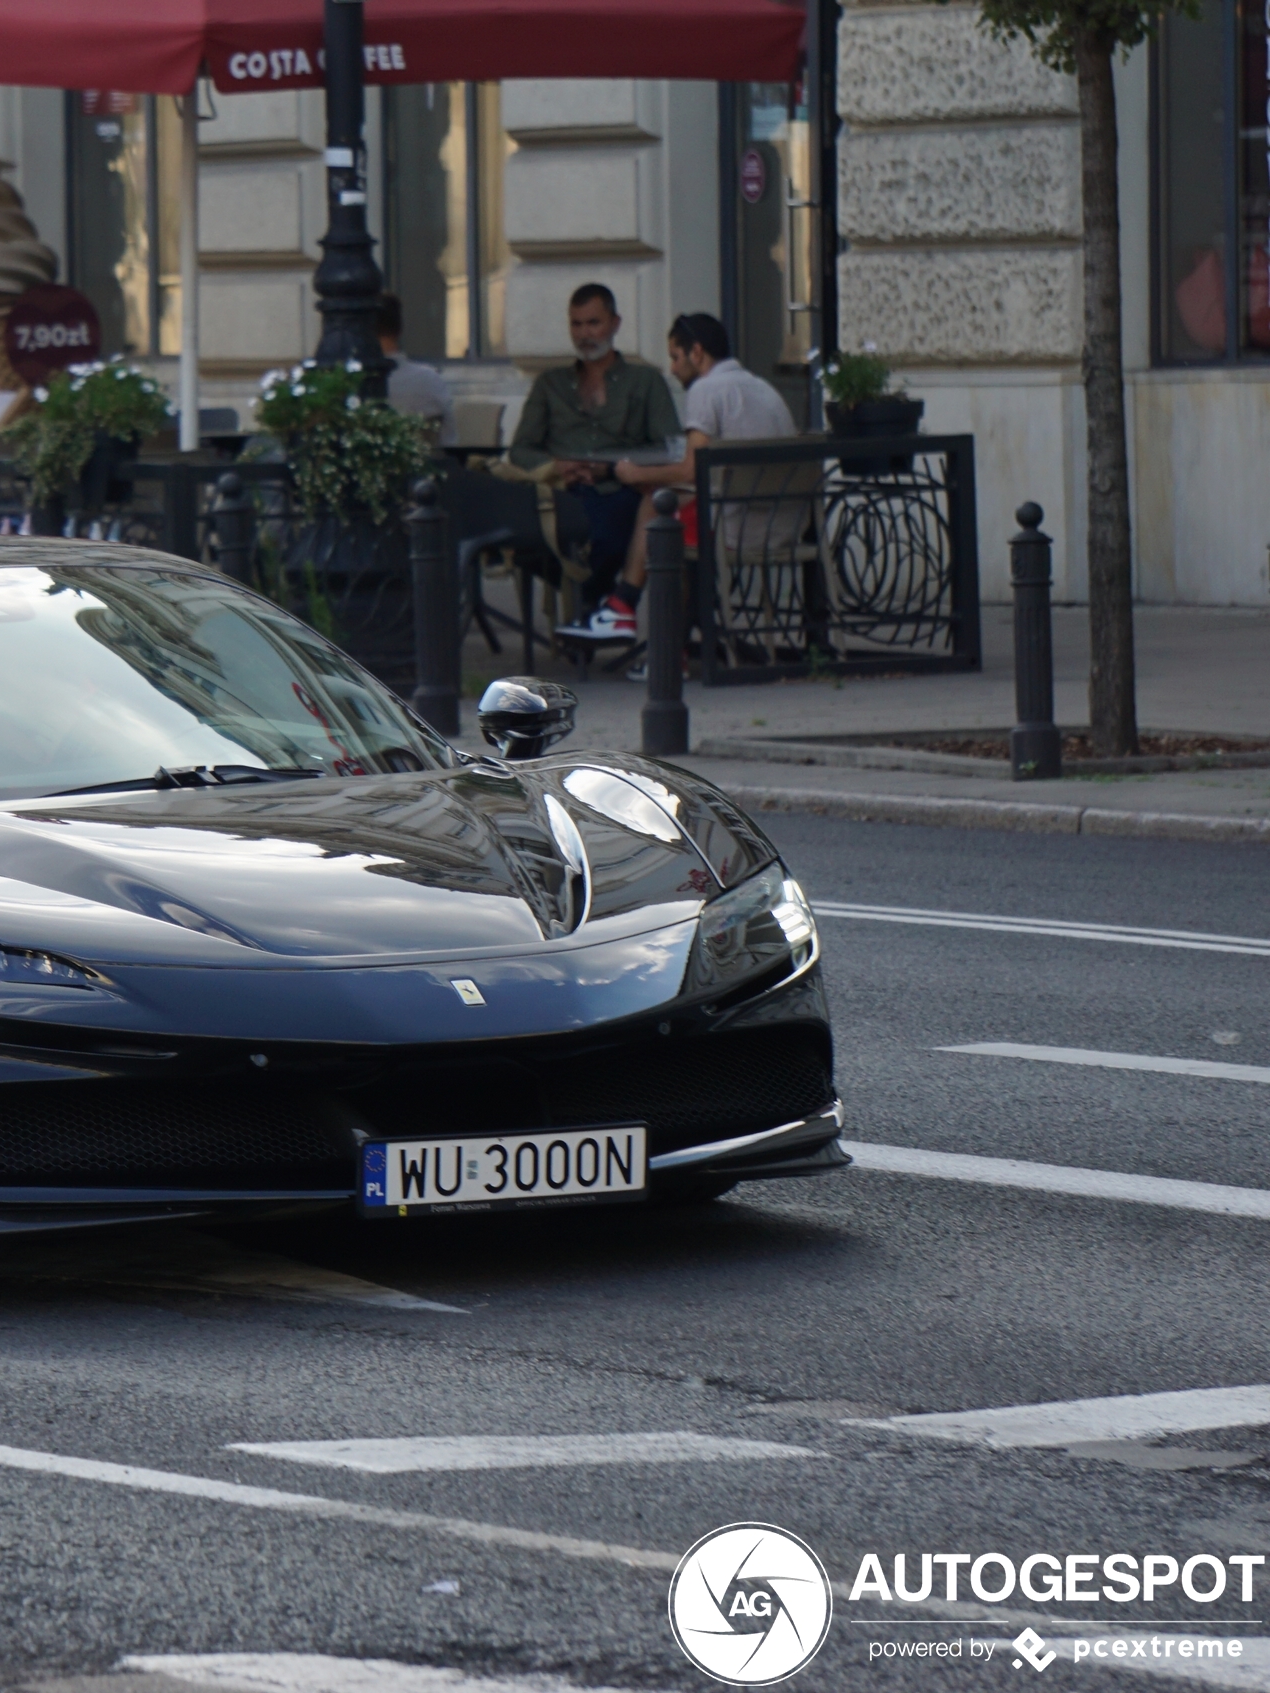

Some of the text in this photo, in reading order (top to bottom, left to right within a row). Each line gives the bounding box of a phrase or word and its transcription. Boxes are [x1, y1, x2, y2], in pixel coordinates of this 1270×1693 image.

[228, 48, 312, 80] COSTA
[399, 1134, 634, 1199] WU 3000N
[366, 1182, 385, 1197] PL
